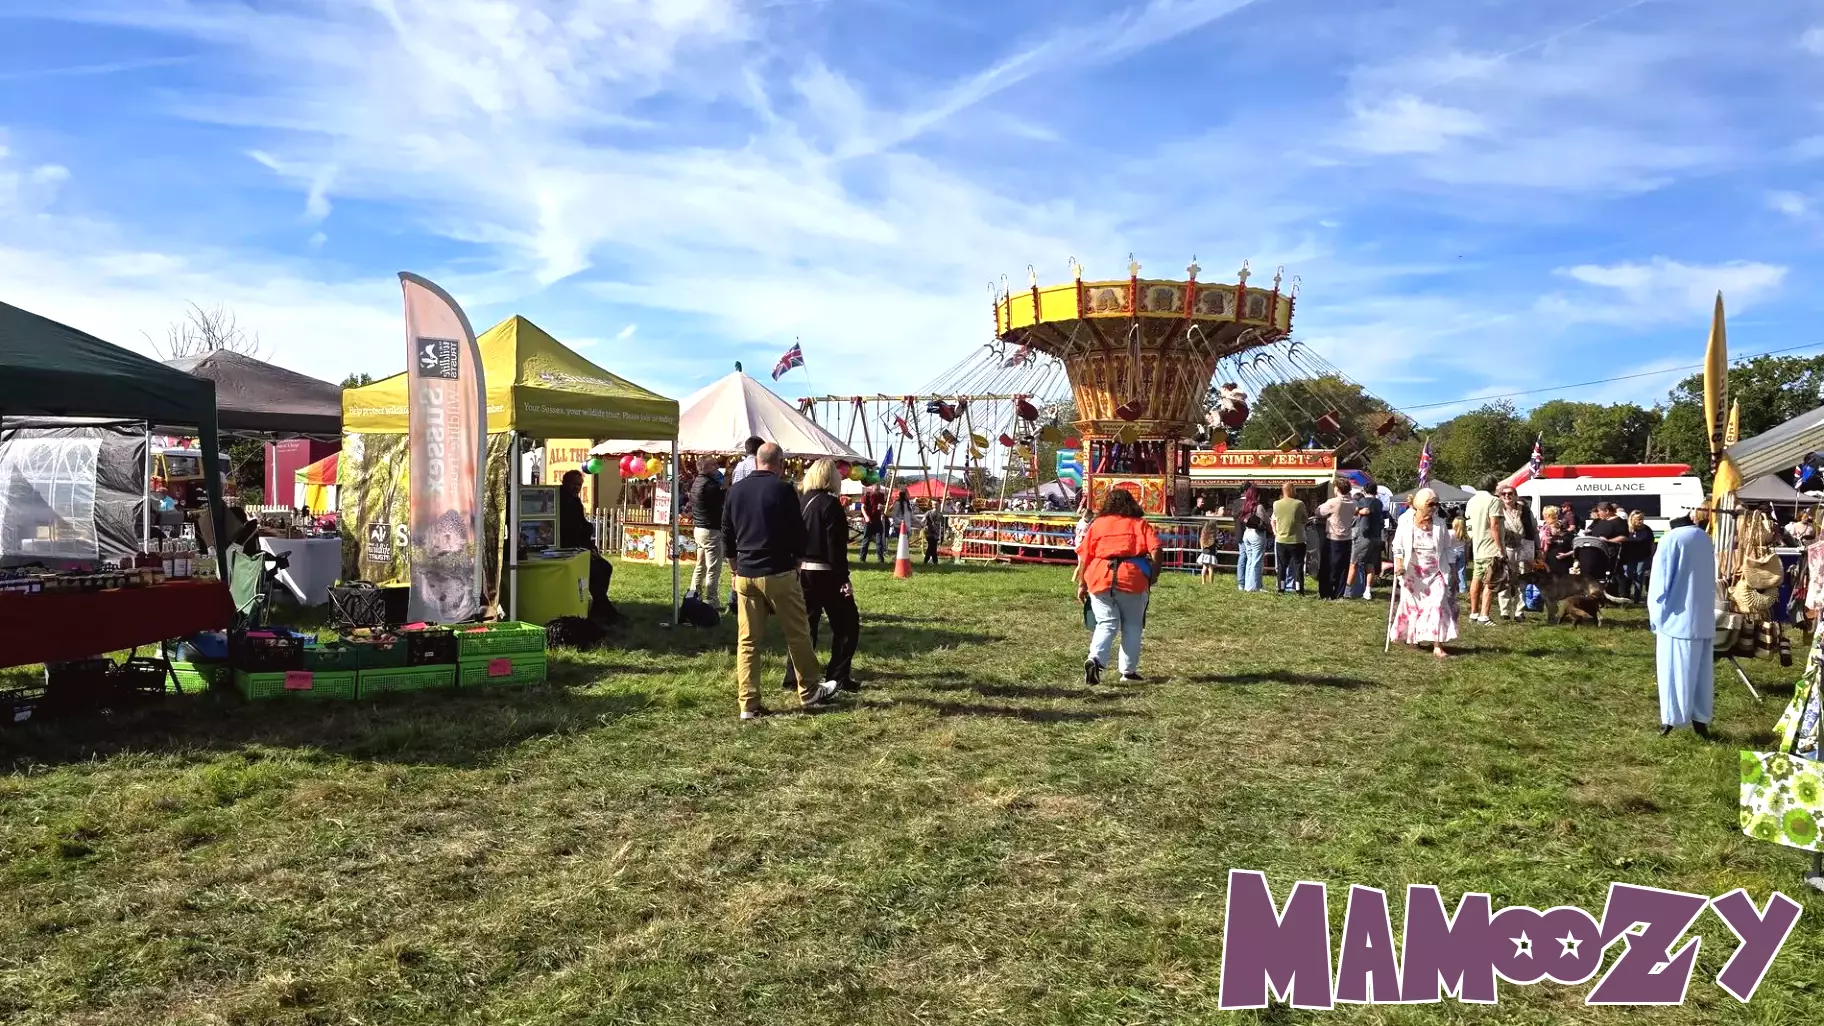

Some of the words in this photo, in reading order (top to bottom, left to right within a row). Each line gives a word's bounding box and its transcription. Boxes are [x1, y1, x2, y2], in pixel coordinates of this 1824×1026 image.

[524, 402, 541, 412] Your
[549, 447, 568, 465] ALL
[569, 447, 589, 463] THE
[1190, 454, 1217, 465] OD
[1219, 454, 1254, 465] TIME
[1575, 483, 1646, 492] AMBULANCE
